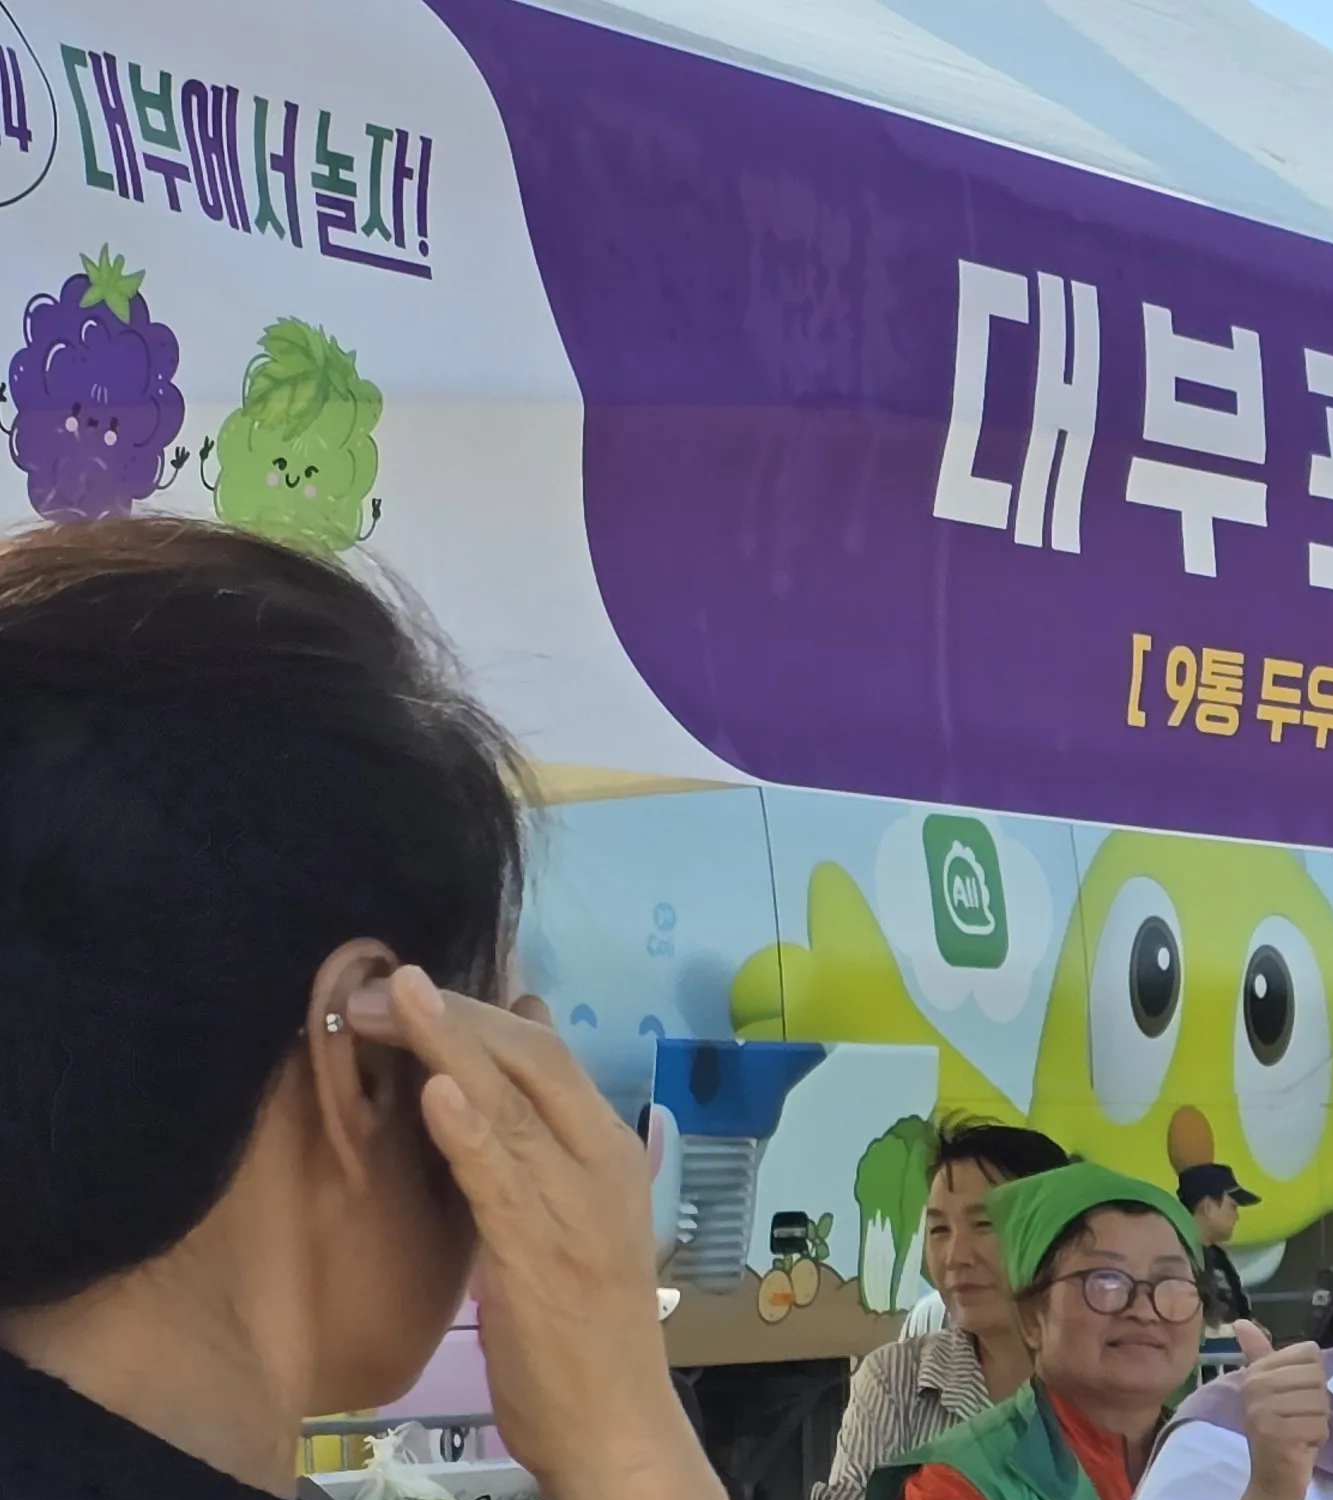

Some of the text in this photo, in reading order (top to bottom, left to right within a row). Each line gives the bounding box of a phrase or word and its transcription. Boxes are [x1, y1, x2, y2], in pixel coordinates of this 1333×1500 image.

[59, 43, 432, 280] 대부에서 놀자!
[1164, 645, 1245, 736] 9통
